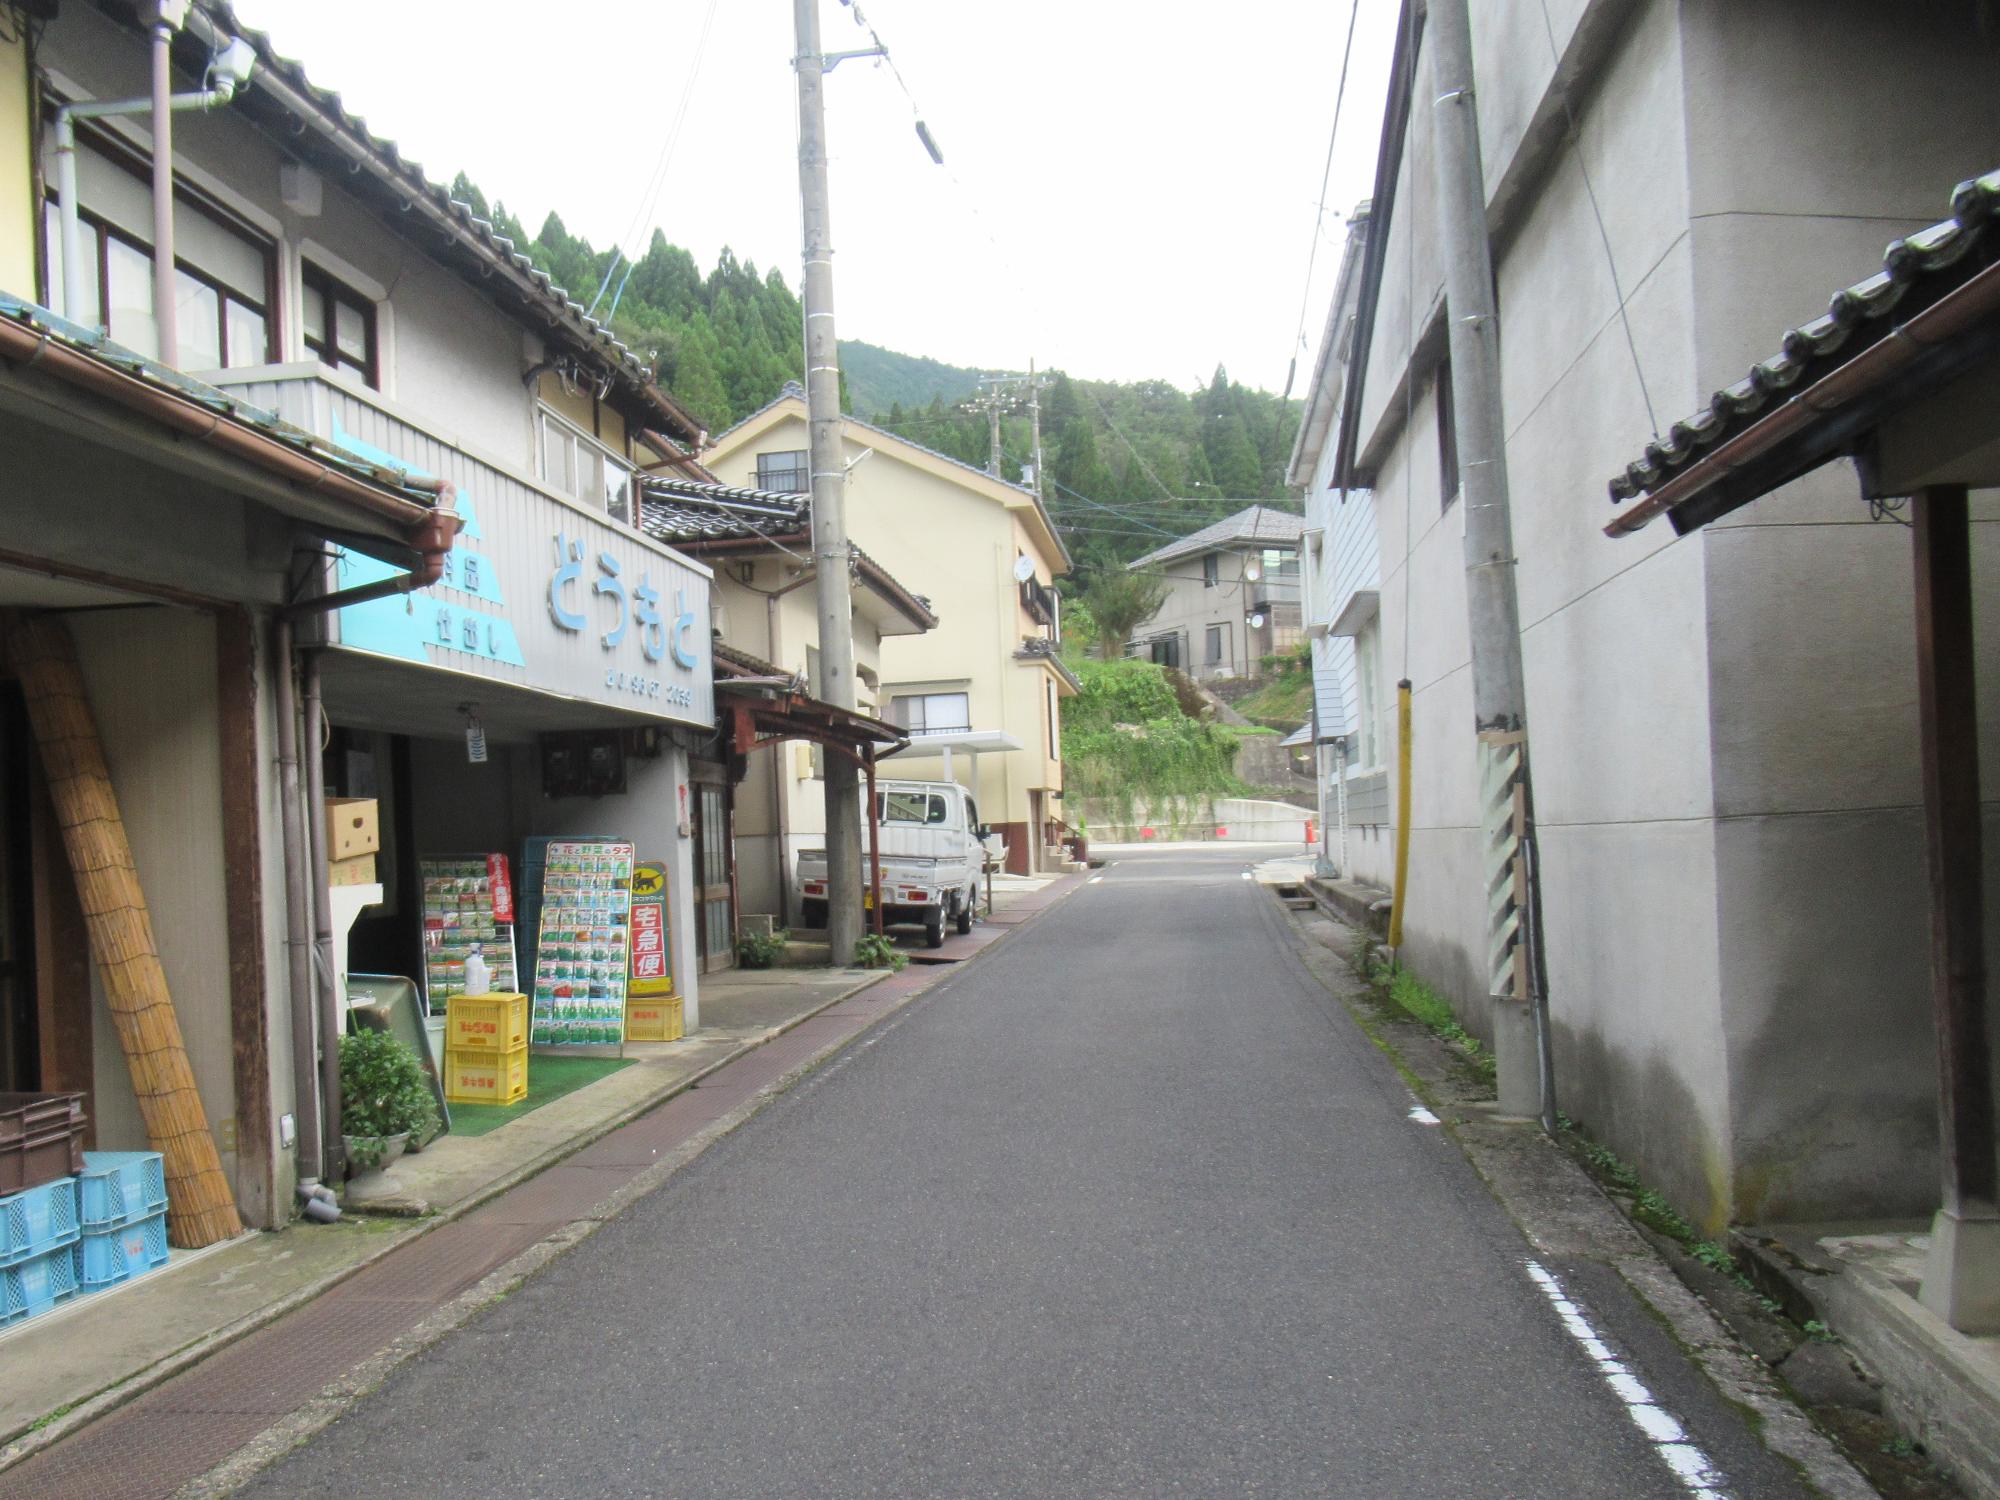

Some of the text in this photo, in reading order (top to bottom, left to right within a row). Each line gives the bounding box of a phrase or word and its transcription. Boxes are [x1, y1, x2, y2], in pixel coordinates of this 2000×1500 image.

[547, 531, 697, 671] どうもと
[437, 607, 499, 655] 仕出し
[563, 845, 632, 855] 花と野菜のタネ
[634, 906, 661, 976] 宅急便
